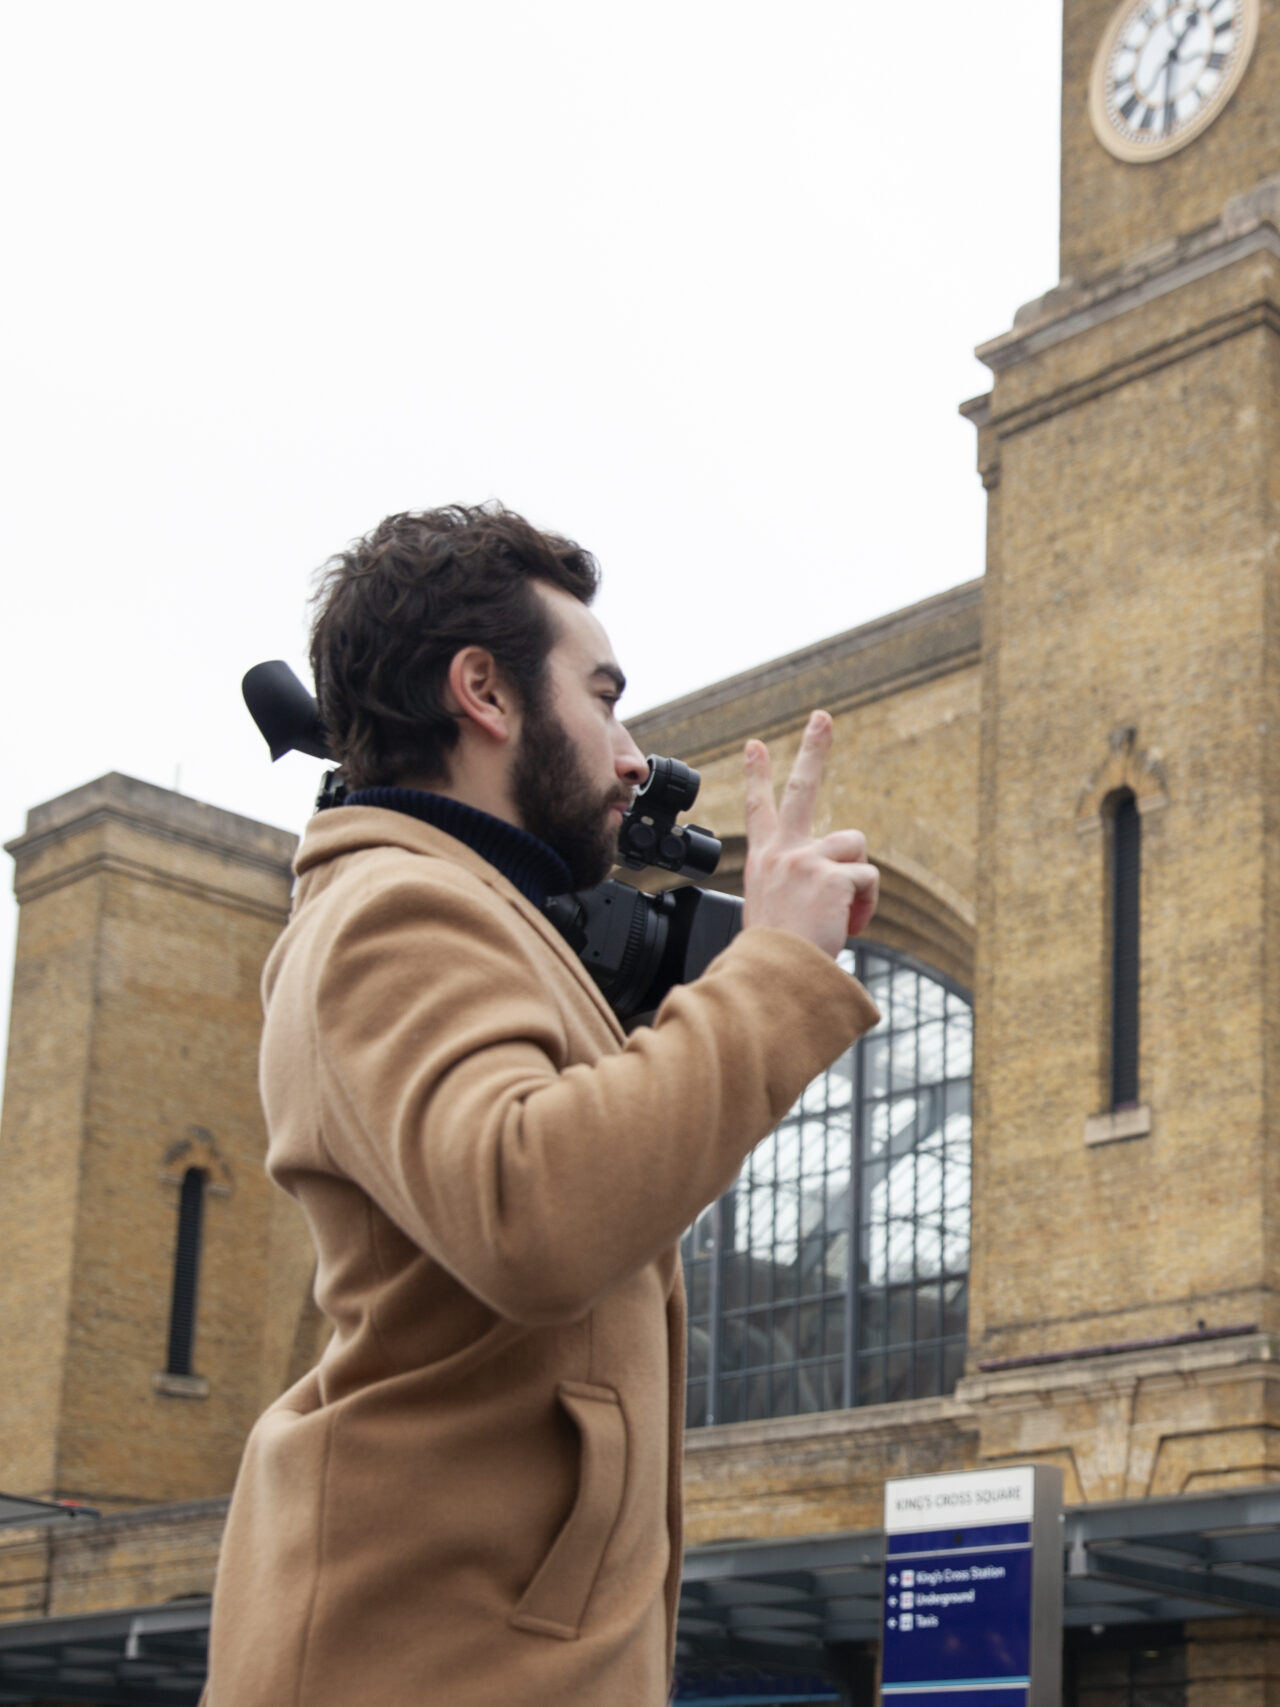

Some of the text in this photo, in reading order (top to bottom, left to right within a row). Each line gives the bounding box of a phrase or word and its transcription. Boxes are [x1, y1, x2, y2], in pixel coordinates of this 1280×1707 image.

[936, 1489, 973, 1508] CROSS
[975, 1485, 1022, 1504] SQUARE
[916, 1565, 1006, 1586] King's Cross Station
[915, 1588, 976, 1607] Underground
[915, 1613, 940, 1628] Taxis
